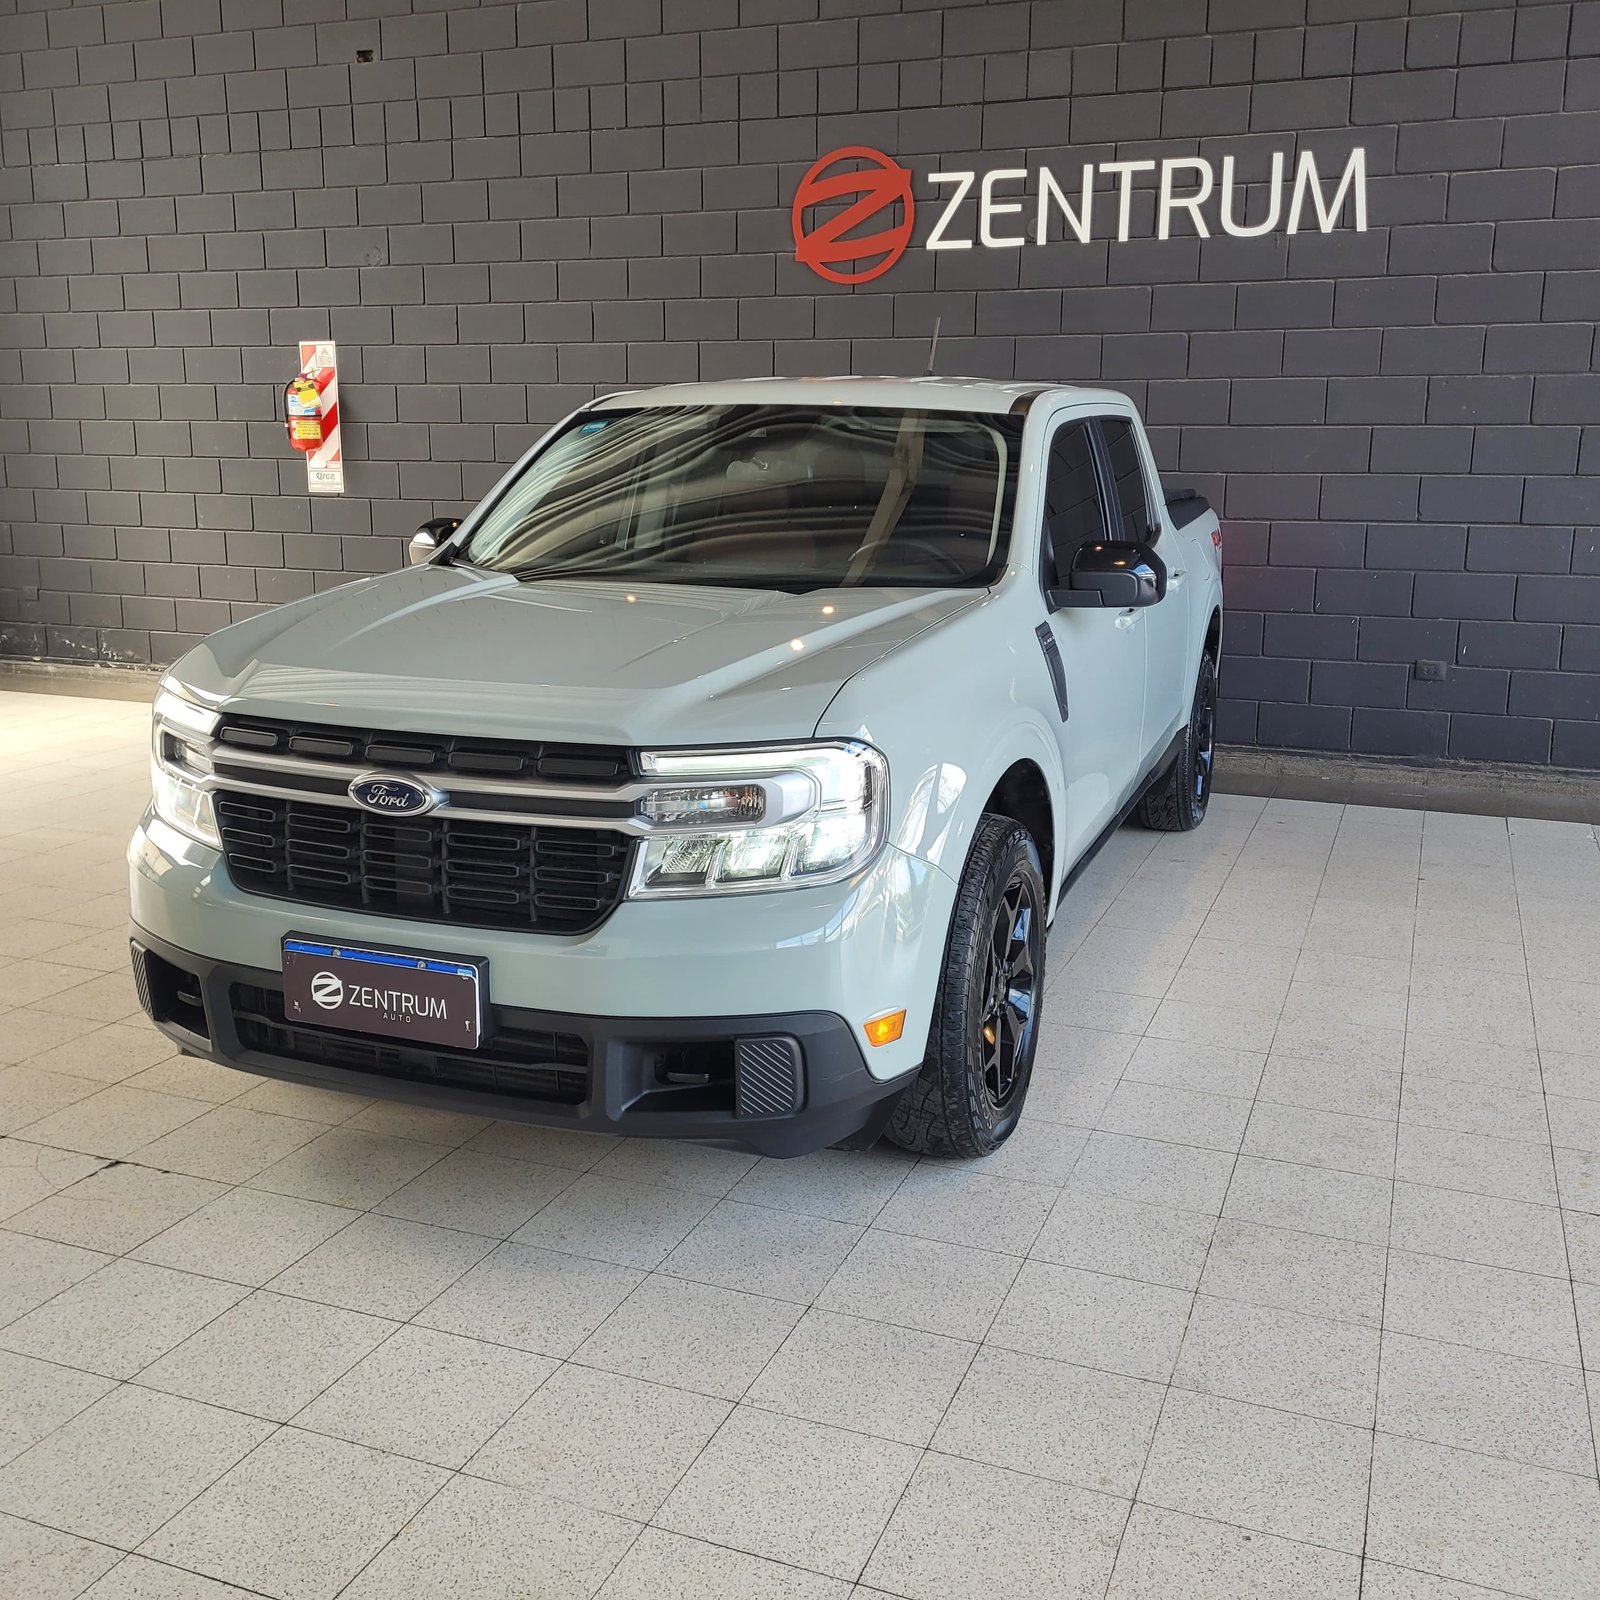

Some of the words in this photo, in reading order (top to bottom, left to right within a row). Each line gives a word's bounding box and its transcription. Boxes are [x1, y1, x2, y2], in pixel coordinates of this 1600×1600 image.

[926, 147, 1367, 251] ZENTRUM
[366, 784, 410, 807] Ford
[348, 984, 448, 1020] ZENTRUM
[382, 1011, 411, 1024] AUTO
